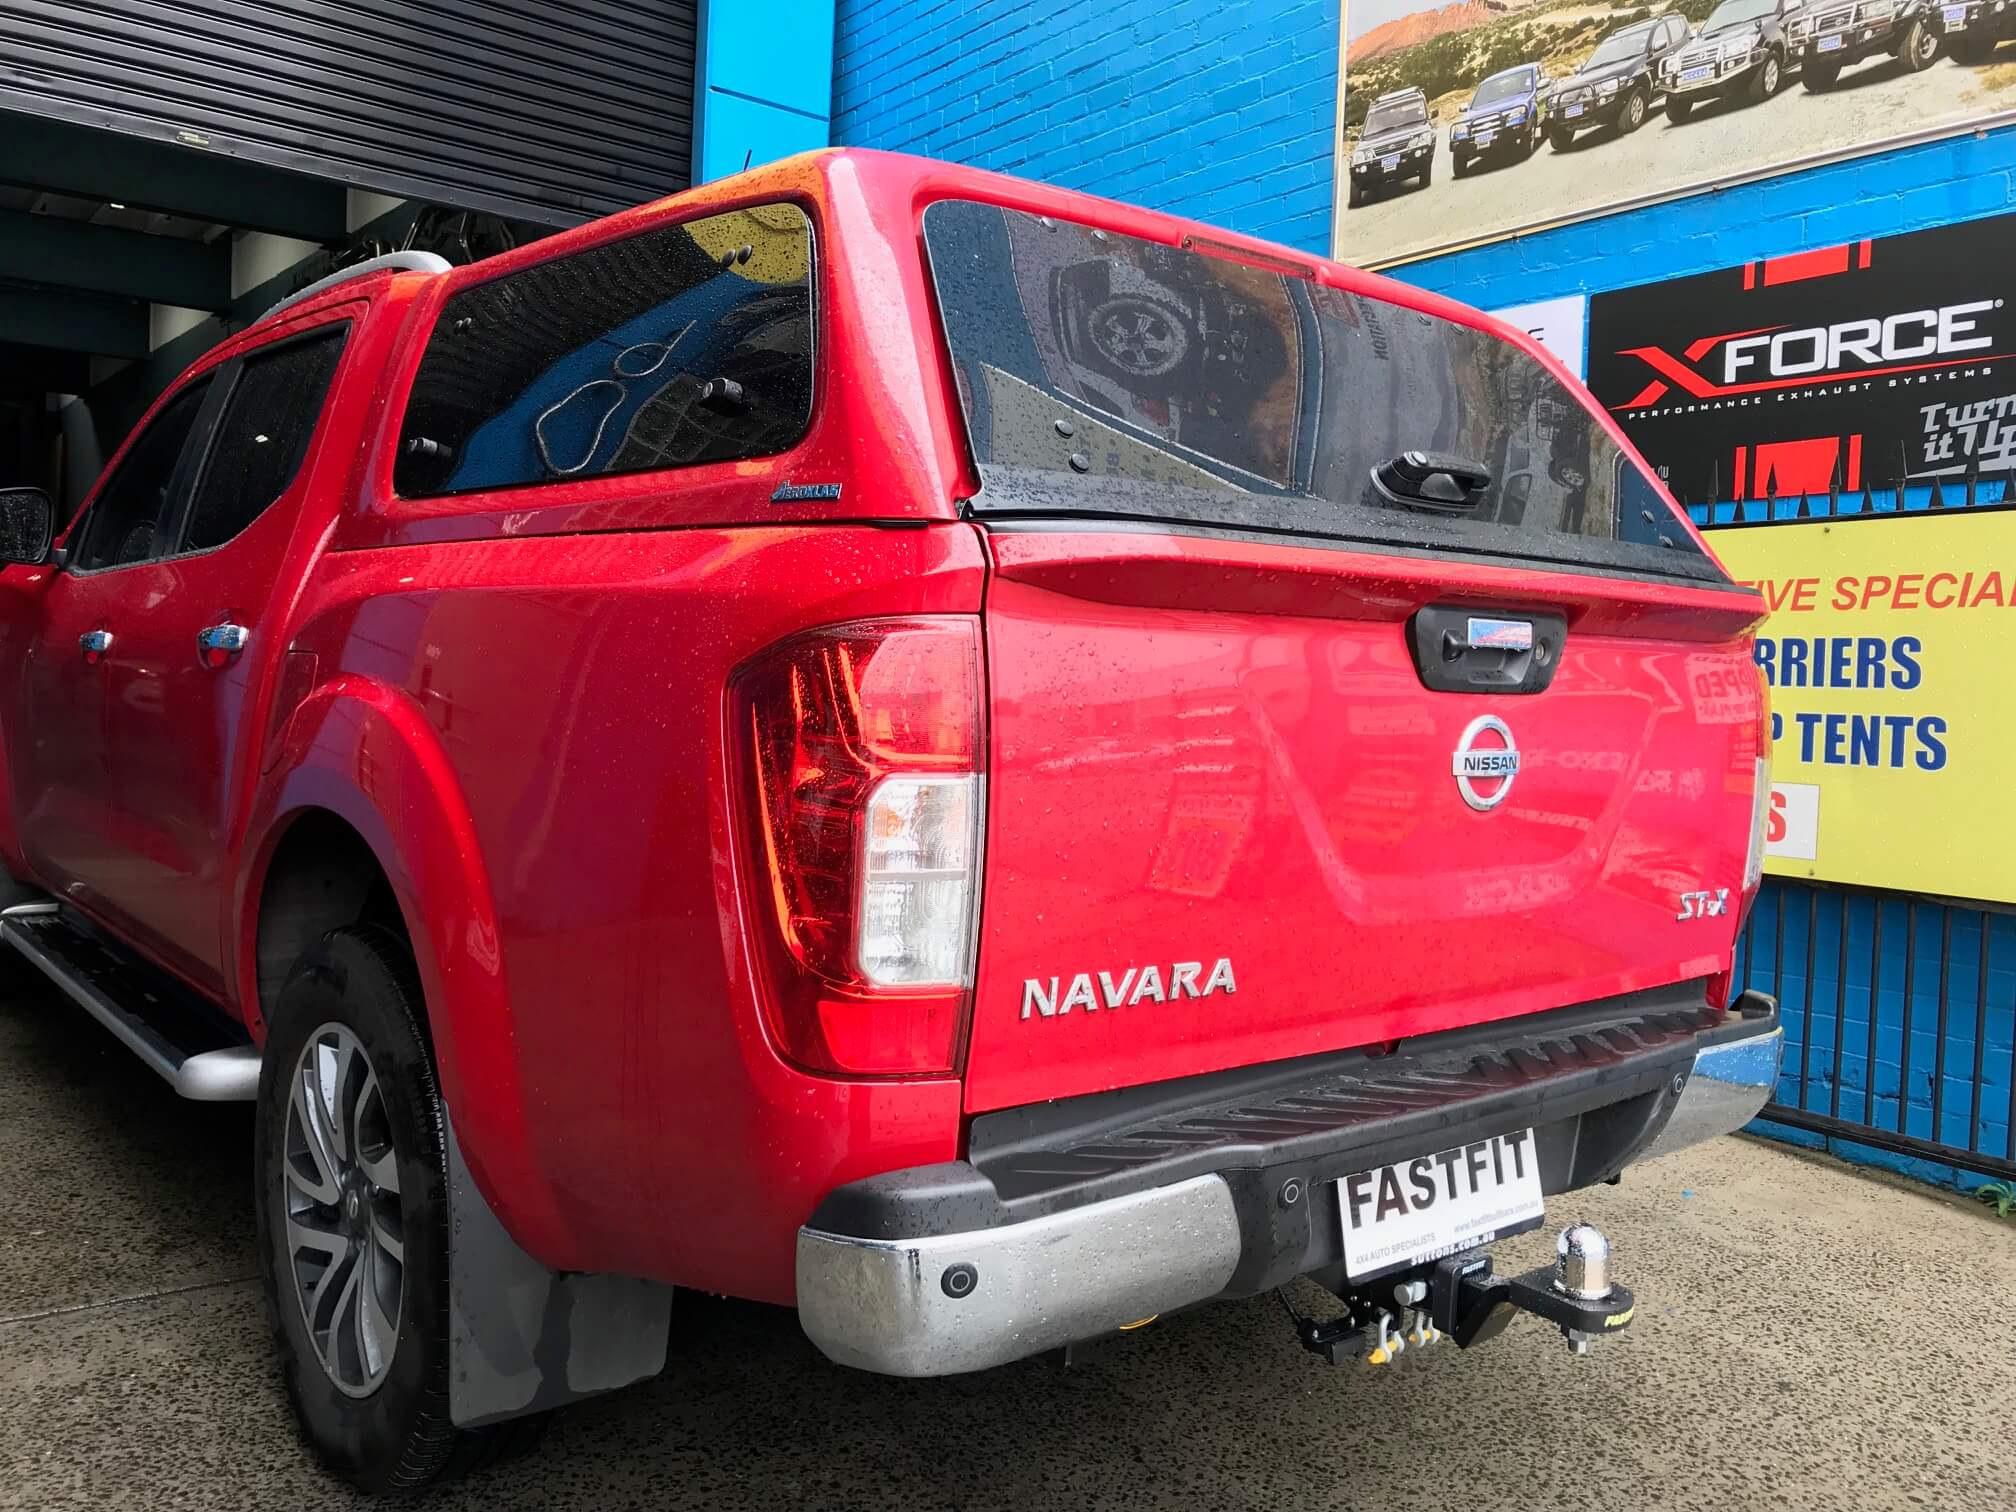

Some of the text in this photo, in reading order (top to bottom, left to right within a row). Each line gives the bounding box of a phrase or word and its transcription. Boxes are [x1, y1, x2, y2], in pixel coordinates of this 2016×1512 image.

[1628, 367, 1992, 420] PERFORMANCE EXHAUST SYSTEMS
[1924, 431, 1955, 462] it
[1464, 756, 1517, 771] NISSAN
[1796, 712, 1947, 771] TENTS
[1020, 957, 1237, 1020] NAVARA
[1346, 1129, 1528, 1230] FASTFIT
[1370, 1246, 1390, 1261] AUTO
[1391, 1232, 1436, 1254] SPECIALISTS
[1411, 1231, 1495, 1266] suttons.com.au
